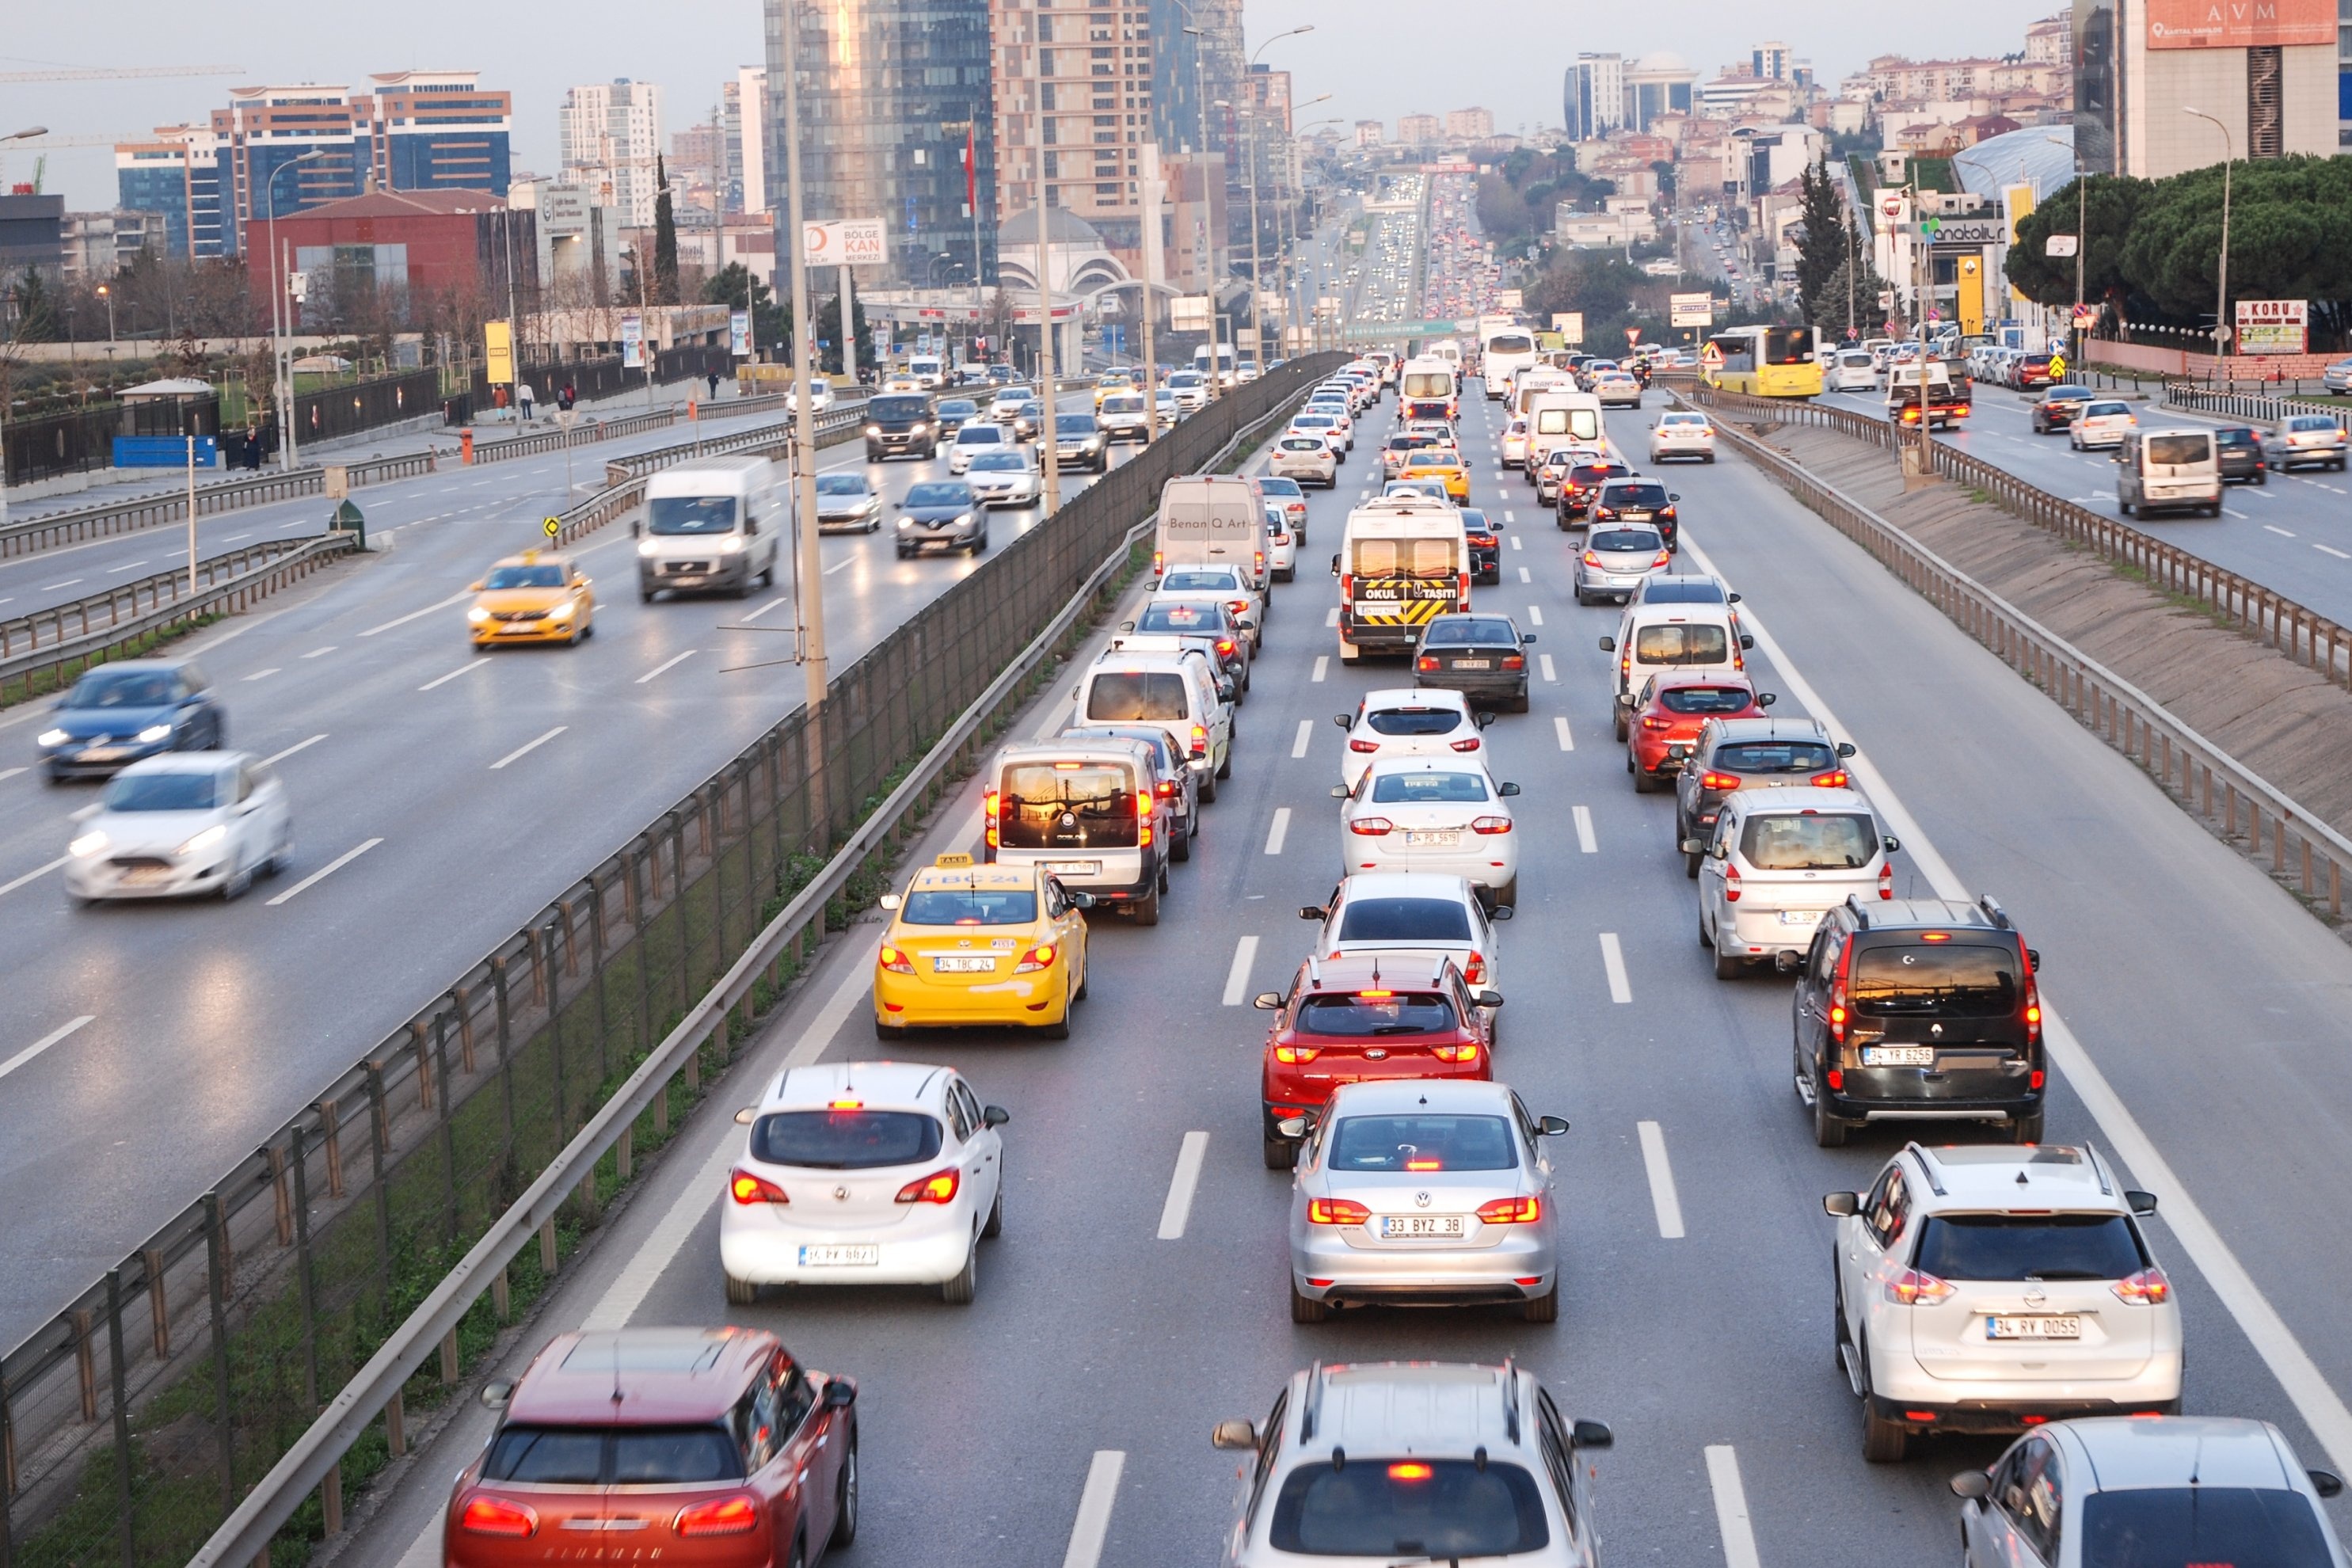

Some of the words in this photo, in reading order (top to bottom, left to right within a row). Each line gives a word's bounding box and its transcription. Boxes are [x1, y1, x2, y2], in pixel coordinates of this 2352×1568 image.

[844, 229, 878, 239] BÖLGE
[845, 239, 879, 253] KAN
[2251, 303, 2289, 316] KORU
[1170, 518, 1207, 528] Benan
[1212, 518, 1224, 529] Q
[1227, 519, 1246, 528] Art
[1365, 589, 1398, 599] OKUL
[1422, 588, 1456, 599] TAŞITI
[940, 959, 950, 969] 34
[957, 959, 972, 969] TBC
[980, 959, 990, 969] 24
[1871, 1049, 1882, 1060] 34
[1890, 1049, 1901, 1060] YR
[1906, 1049, 1931, 1060] 6256
[1390, 1220, 1404, 1231] 33
[1414, 1220, 1435, 1231] BYZ
[1445, 1219, 1460, 1231] 38
[1996, 1320, 2011, 1334] 34
[2043, 1319, 2076, 1334] 0055
